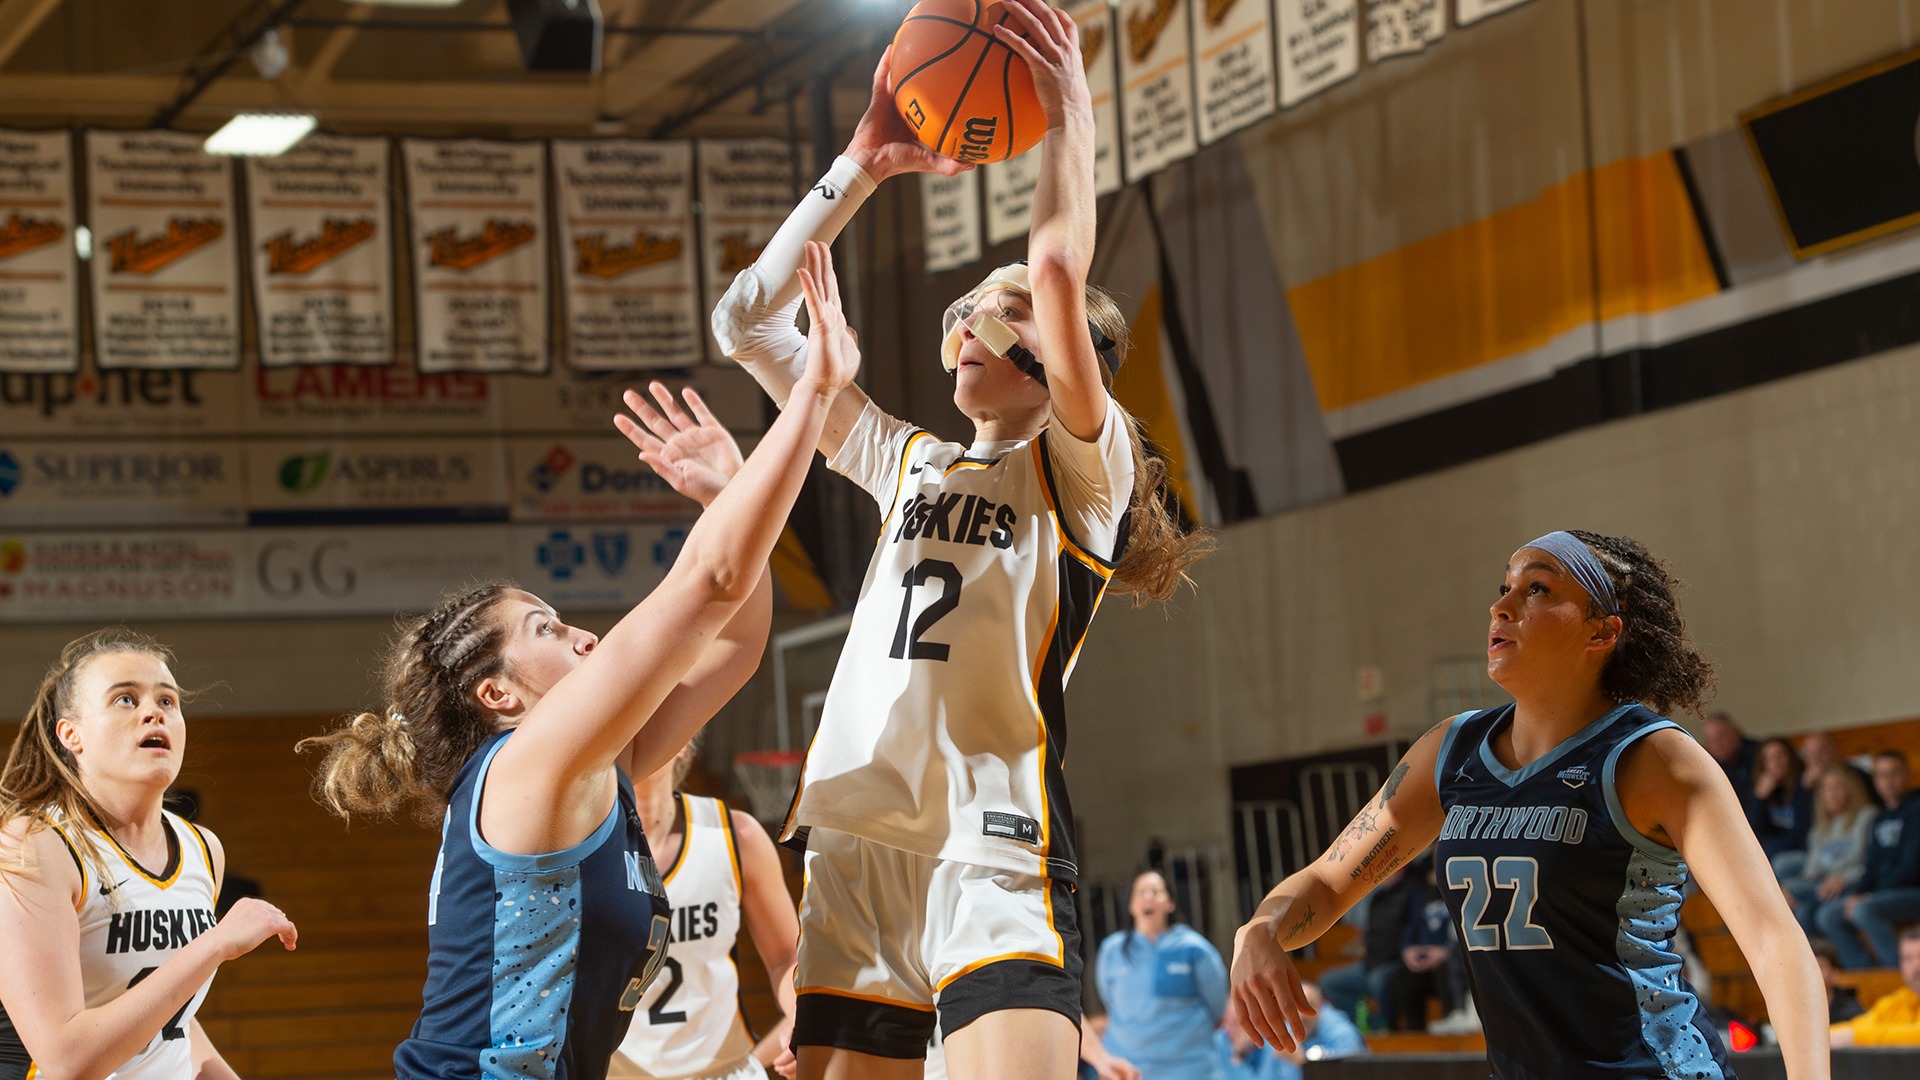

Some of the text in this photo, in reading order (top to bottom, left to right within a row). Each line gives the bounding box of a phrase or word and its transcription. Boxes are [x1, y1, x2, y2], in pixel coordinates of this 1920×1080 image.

[332, 455, 473, 482] ASPIRUS
[256, 536, 358, 600] GG
[889, 558, 963, 662] 12
[1022, 823, 1032, 835] M
[1439, 805, 1588, 845] ORTHWOOD
[1350, 826, 1397, 880] MY BROTHERS
[1446, 856, 1554, 951] 22
